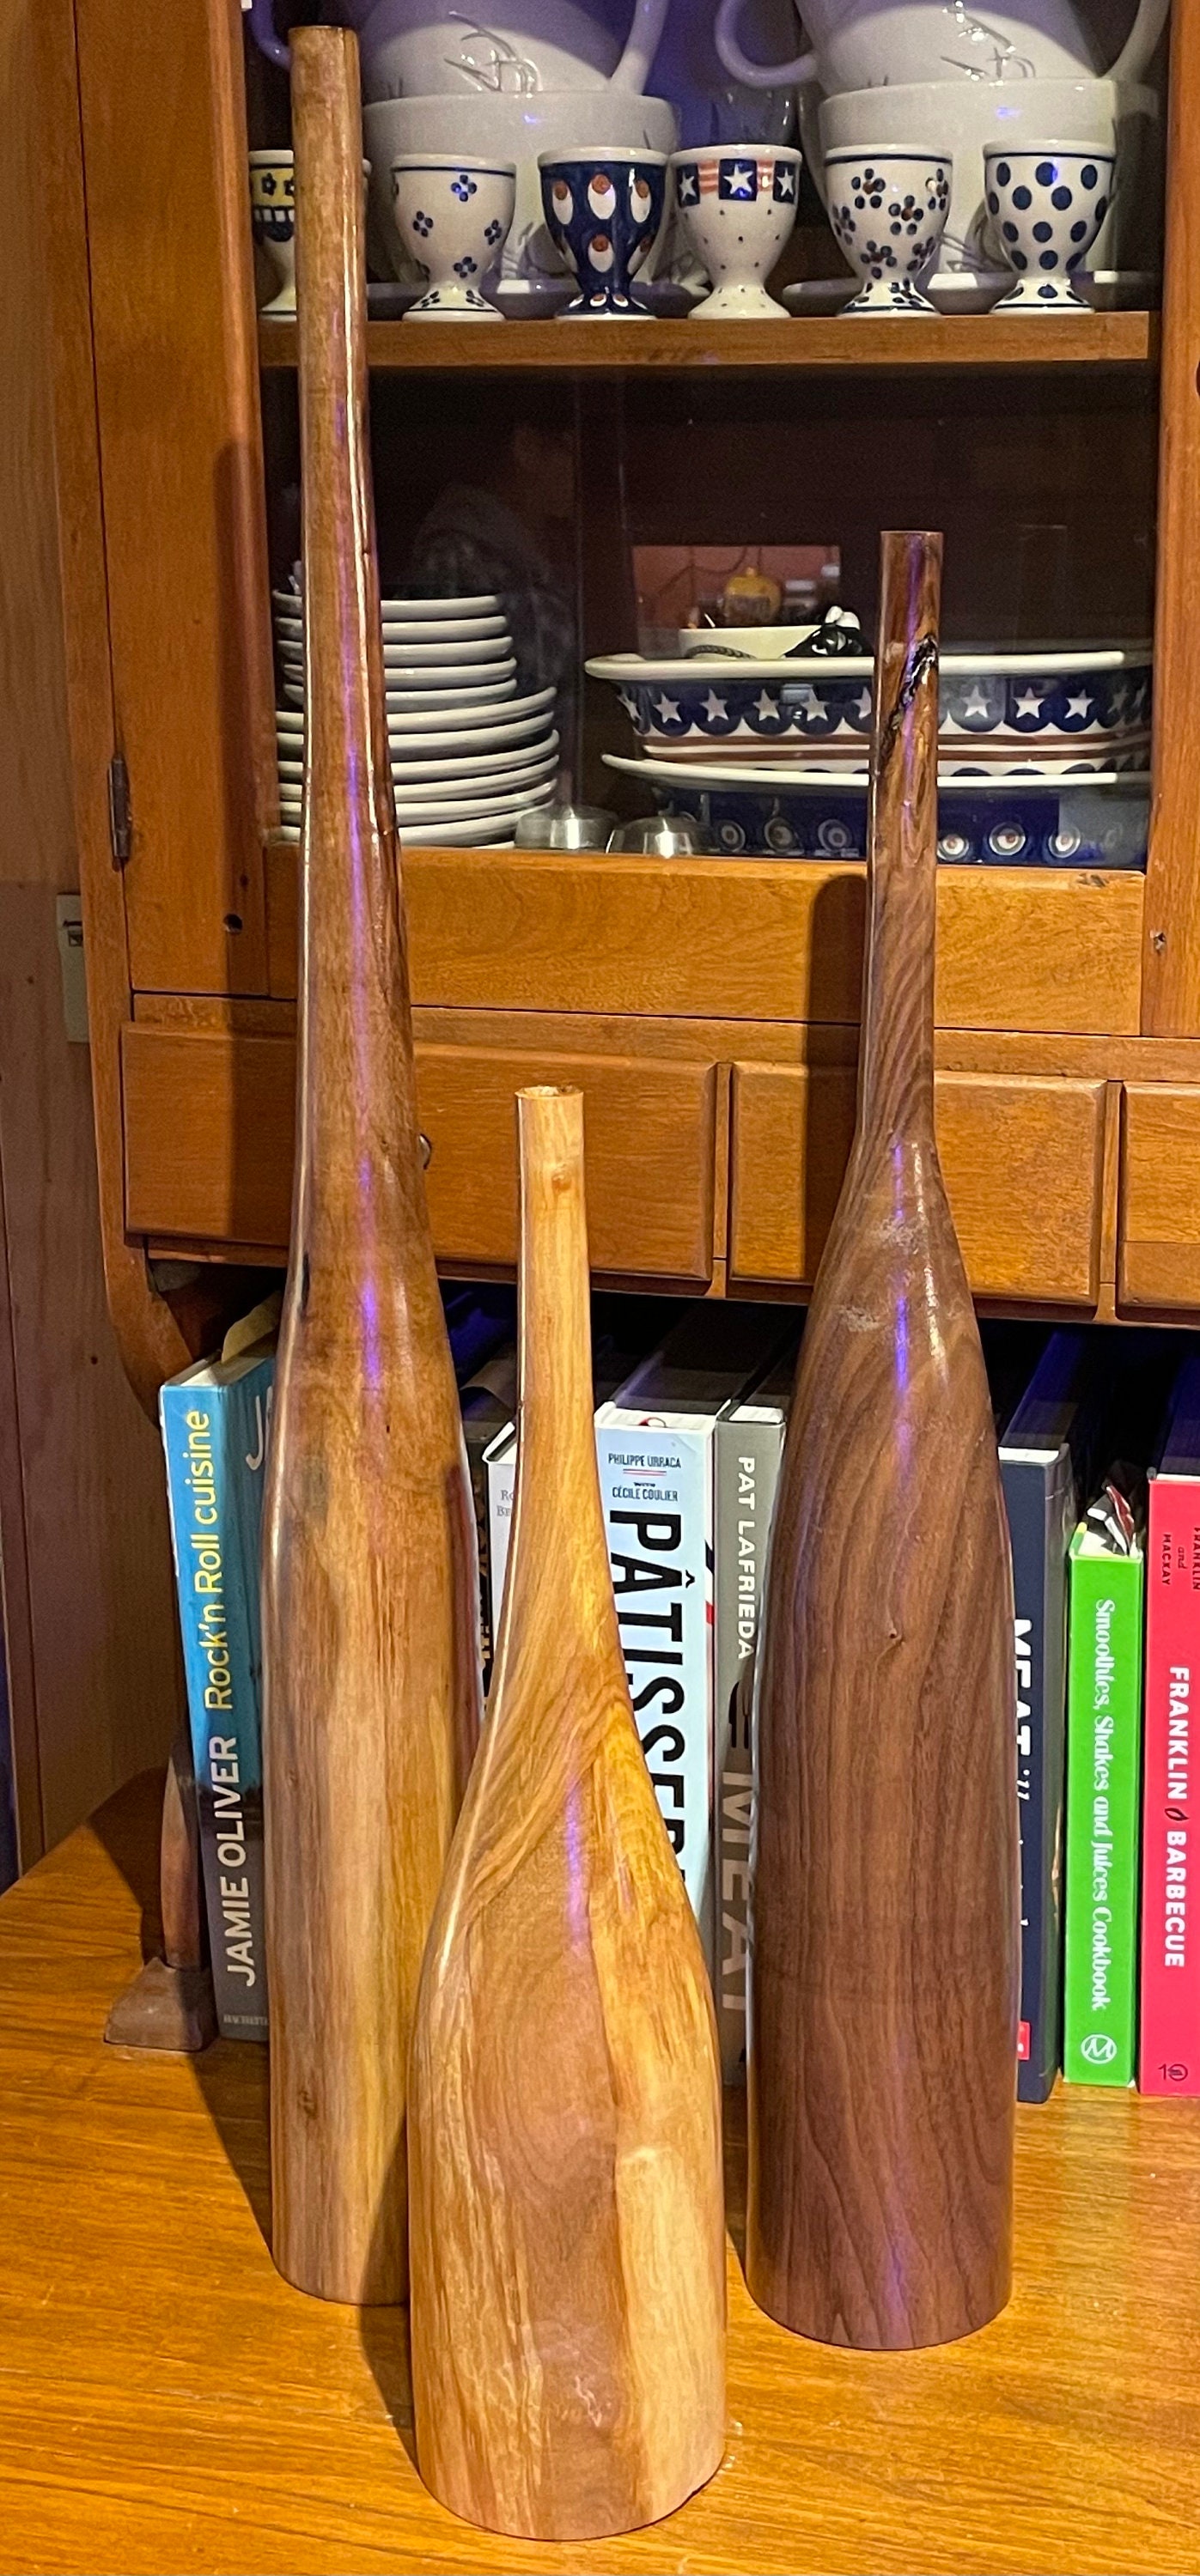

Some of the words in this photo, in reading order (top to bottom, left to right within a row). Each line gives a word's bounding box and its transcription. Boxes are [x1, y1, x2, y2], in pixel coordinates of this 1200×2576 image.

[183, 1410, 217, 1524] cuisine
[608, 1453, 645, 1467] PHILIPPE
[643, 1489, 678, 1502] COULIER
[738, 1457, 755, 1510] PAT
[191, 1534, 222, 1593] Roll
[738, 1522, 755, 1659] LAFRIEDA
[1162, 1534, 1172, 1585] MACKAY
[1178, 1546, 1188, 1570] and
[198, 1604, 232, 1709] Rock'n
[1093, 1599, 1115, 1710] Smoothies,
[1093, 1716, 1114, 1791] Shakes
[1166, 1666, 1189, 1800] FRANKLIN
[210, 1735, 247, 1866] OLIVER
[1093, 1796, 1113, 1837] and
[1091, 1840, 1113, 1902] Juices
[1164, 1830, 1187, 1968] BARBECUE
[220, 1876, 256, 1986] JAMIE
[1092, 1906, 1112, 2011] Cookbook
